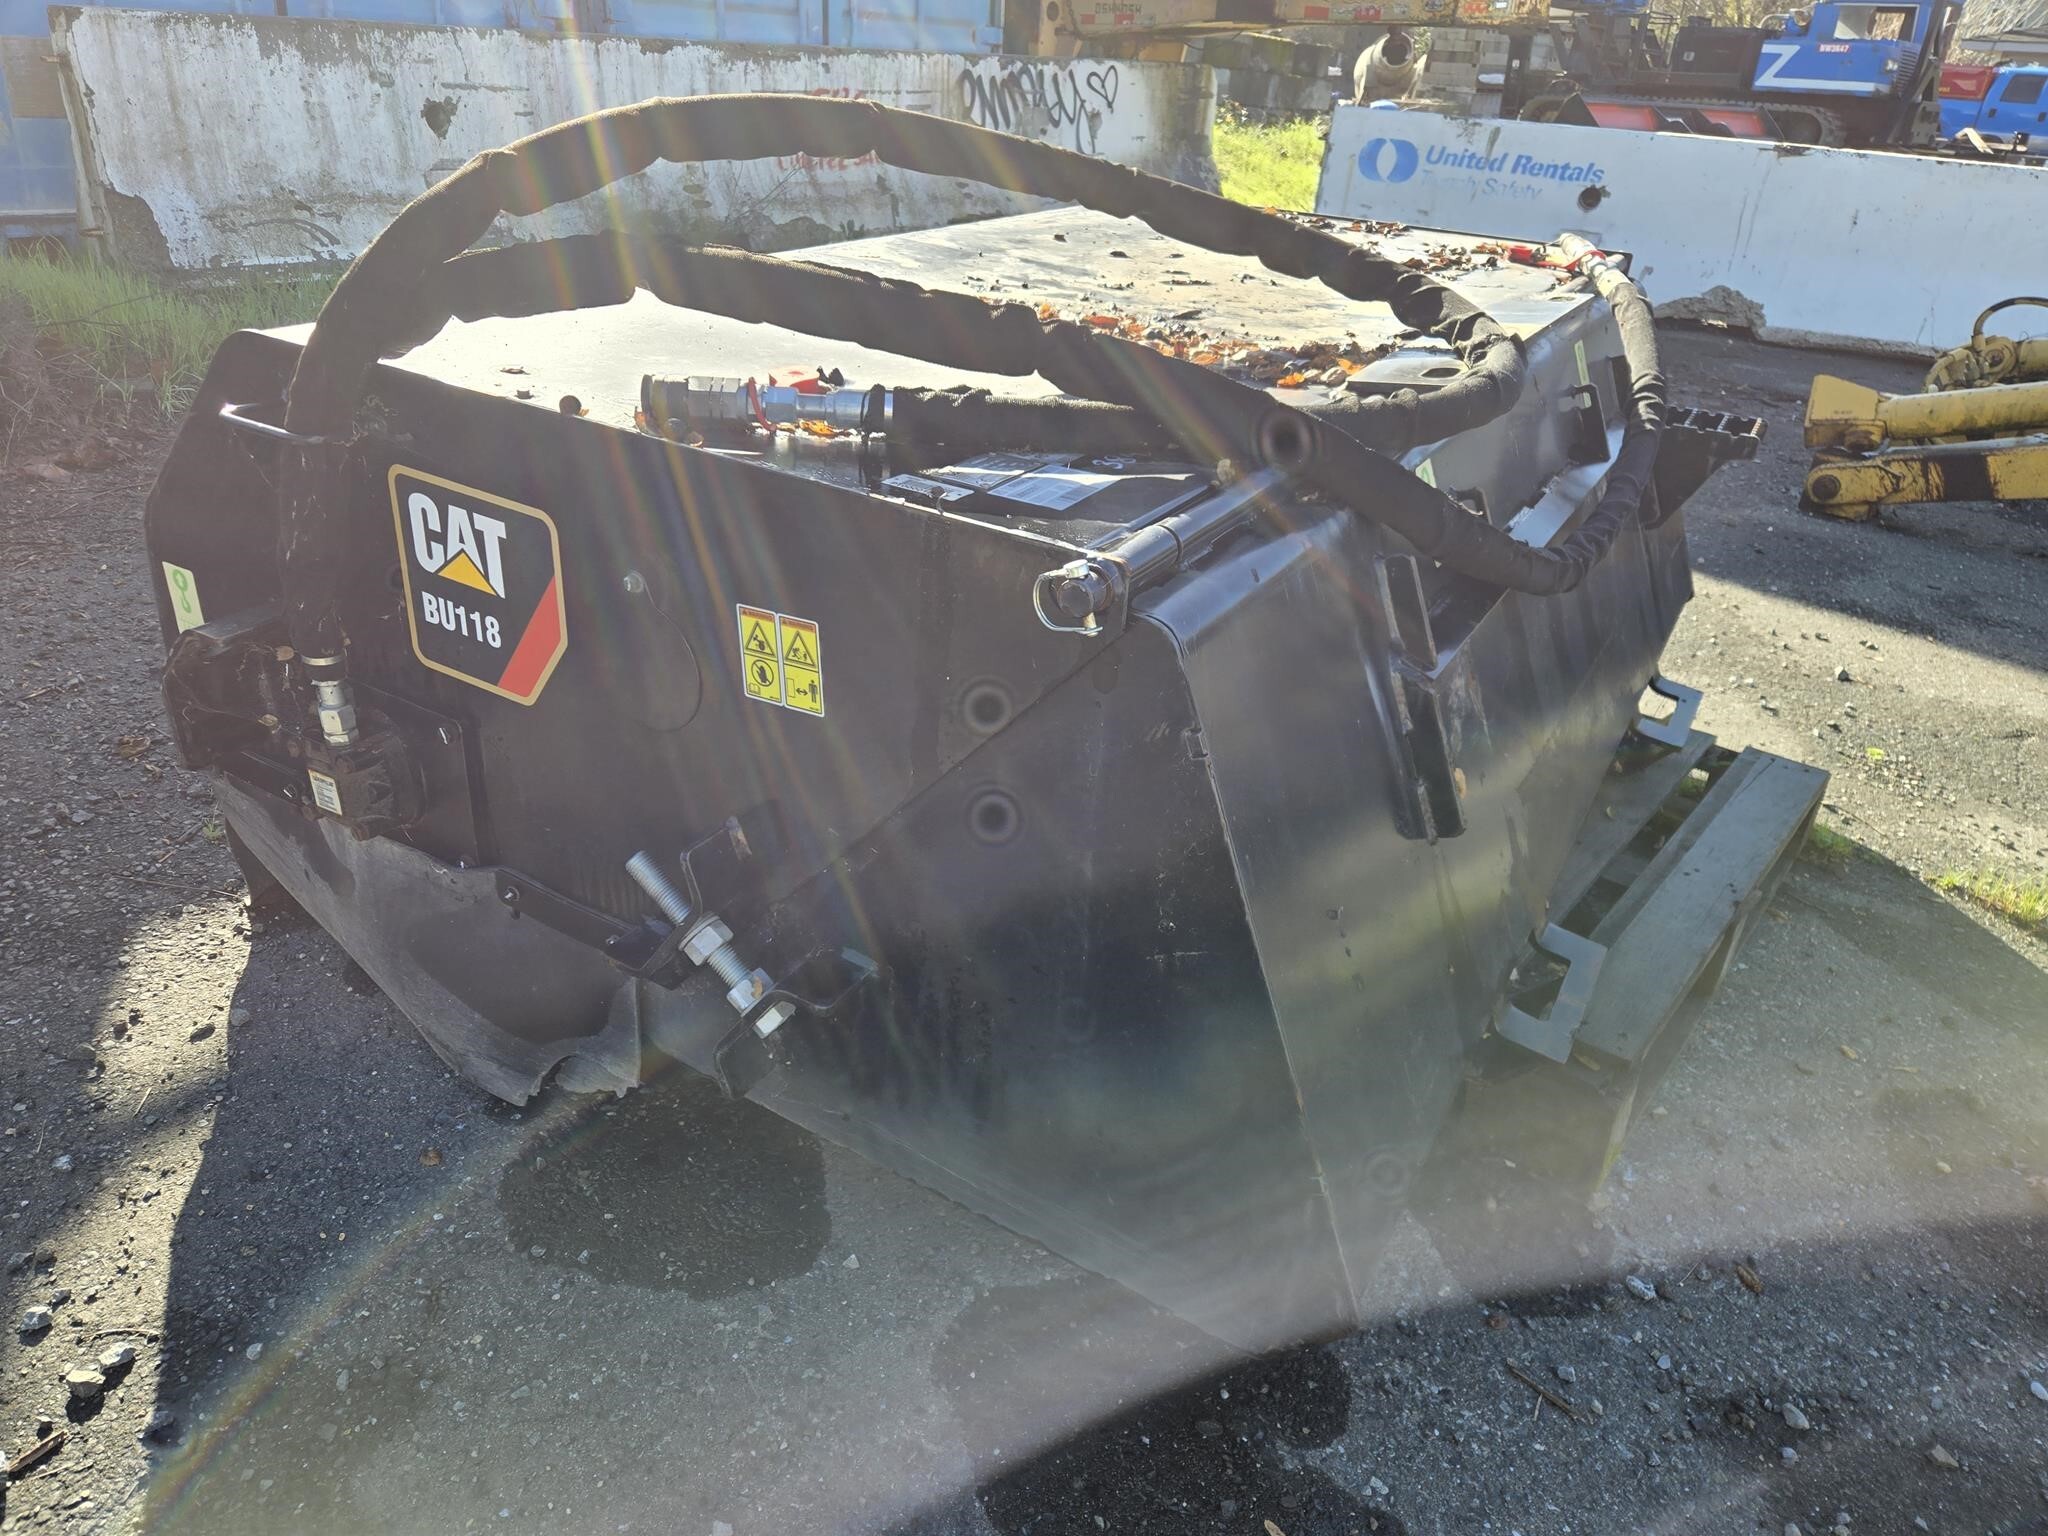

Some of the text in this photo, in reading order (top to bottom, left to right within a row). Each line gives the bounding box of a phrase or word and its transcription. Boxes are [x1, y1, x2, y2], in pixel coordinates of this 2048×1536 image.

[1425, 144, 1605, 184] United Rentals
[408, 492, 507, 600] CAT
[421, 591, 502, 648] BU118
